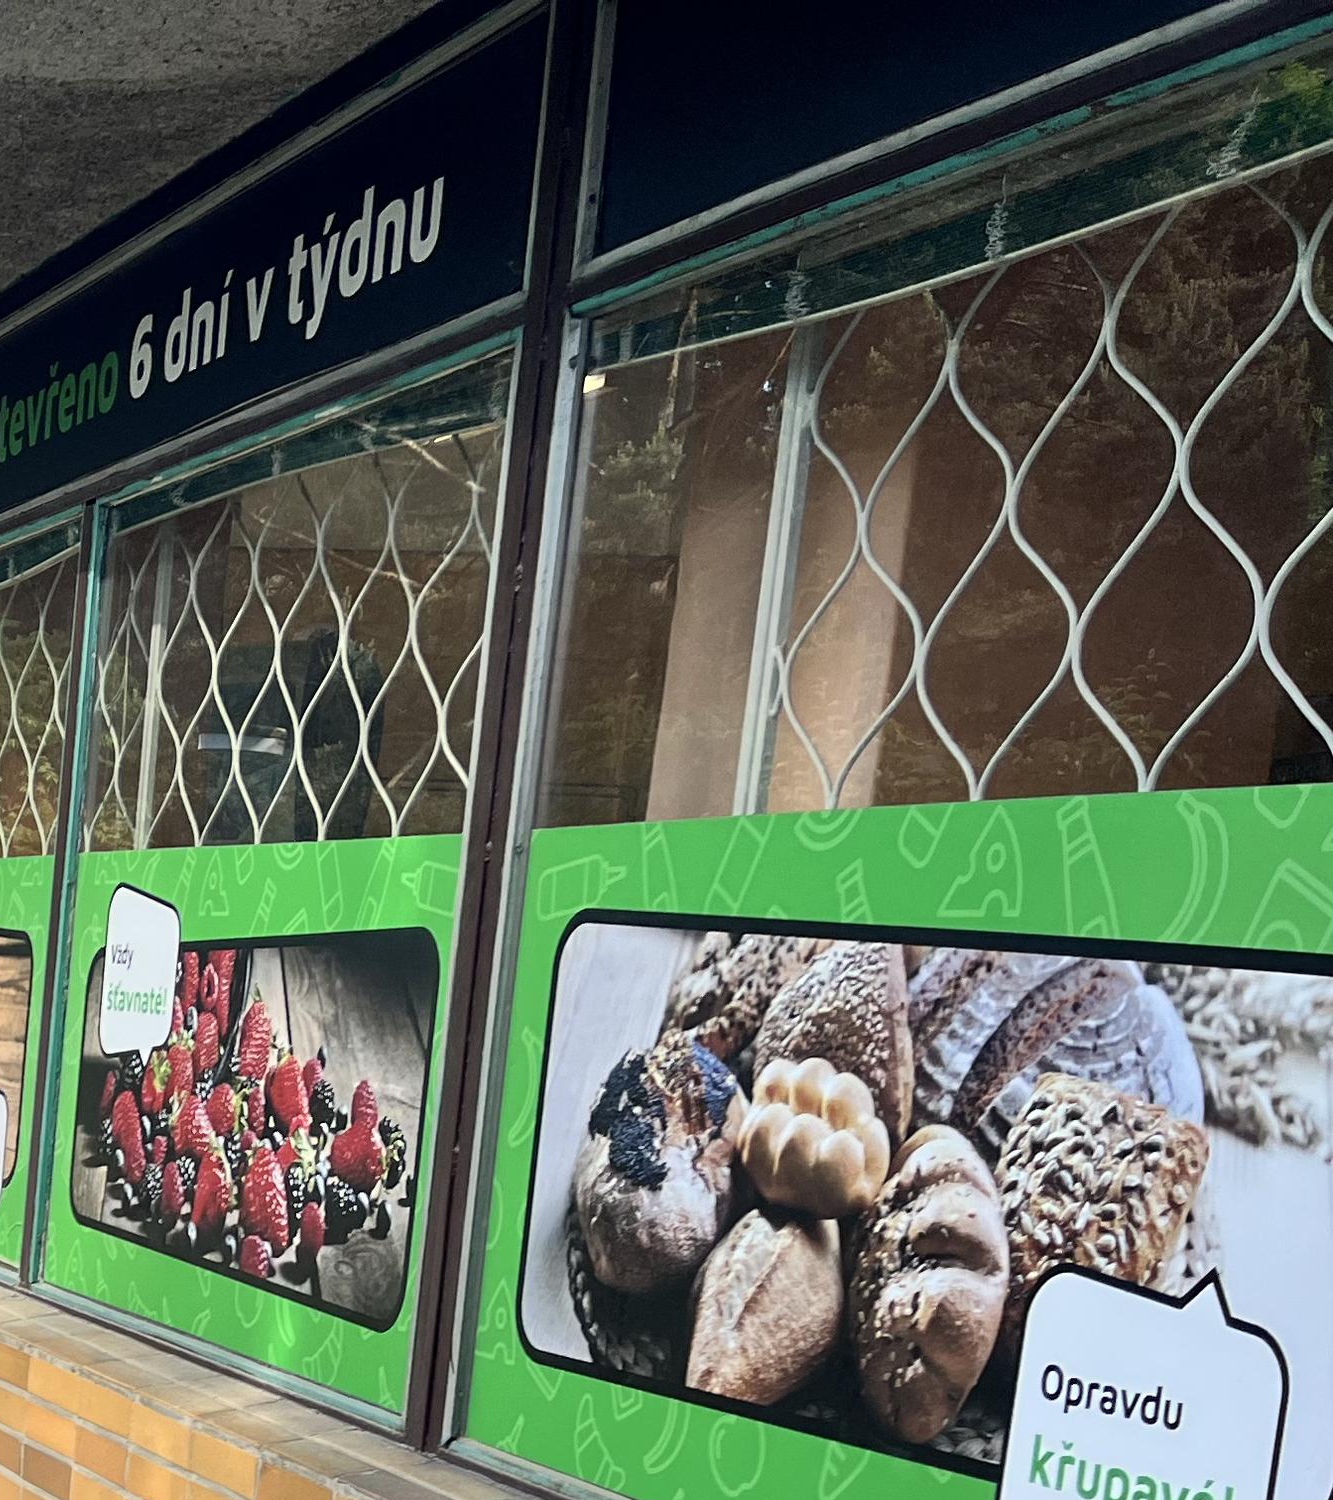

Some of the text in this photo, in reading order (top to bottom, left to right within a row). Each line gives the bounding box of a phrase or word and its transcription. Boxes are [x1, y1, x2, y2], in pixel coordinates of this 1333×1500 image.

[129, 314, 154, 399] 6
[163, 270, 233, 383] dní
[246, 266, 275, 342] v
[288, 176, 445, 340] týdnu
[106, 981, 168, 1015] šťavnaté!
[1041, 1364, 1183, 1430] Opravdu
